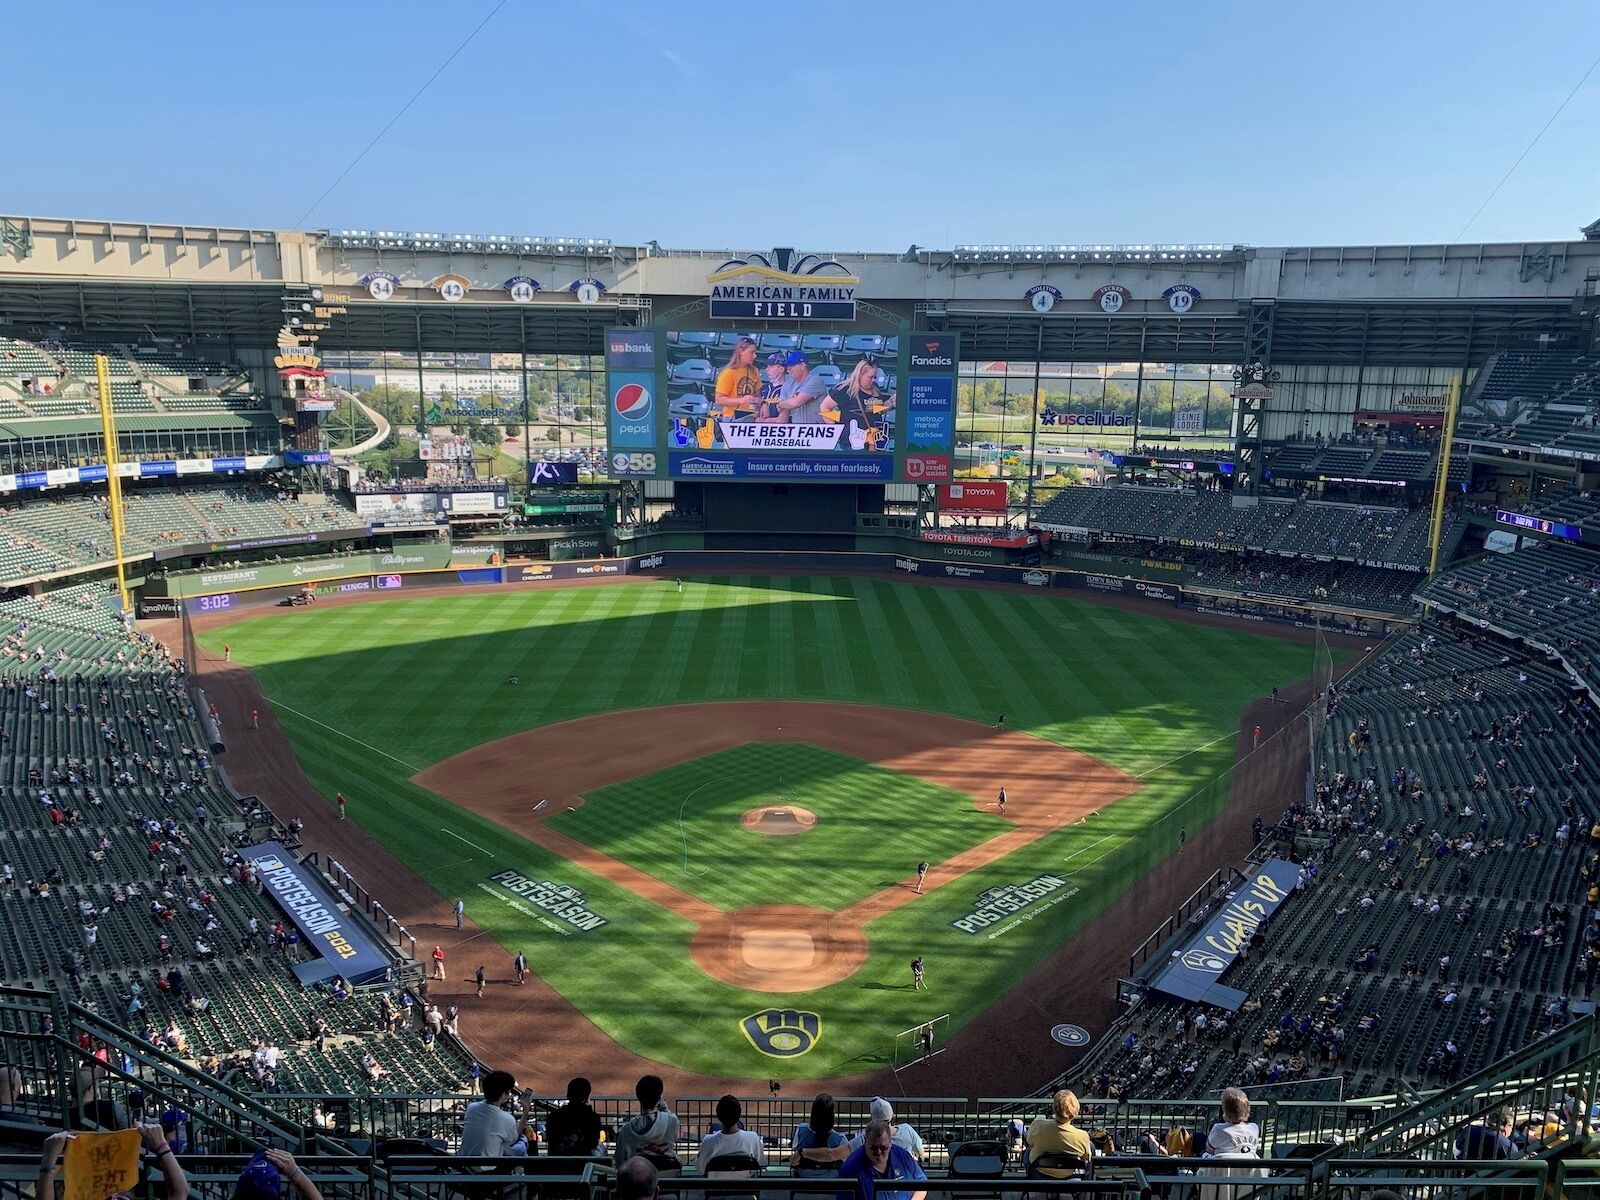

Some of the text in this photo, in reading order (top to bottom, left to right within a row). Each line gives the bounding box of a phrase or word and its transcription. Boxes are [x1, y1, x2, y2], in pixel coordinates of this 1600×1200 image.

[368, 272, 394, 281] FINGERS
[372, 282, 391, 295] 34
[443, 284, 462, 297] 42
[513, 286, 530, 299] 44
[712, 286, 855, 300] AMERICAN FAMILY
[1030, 284, 1057, 294] MOLITOR
[1172, 285, 1193, 293] YOUNT
[1037, 295, 1046, 308] 4
[1105, 293, 1119, 305] 50
[1173, 295, 1190, 308] 19
[754, 302, 812, 317] FIELD
[911, 354, 952, 366] Fanatics
[444, 407, 525, 418] Associated Bank
[1177, 413, 1201, 421] LEINIE
[620, 424, 649, 435] pepsi
[729, 425, 835, 438] THE BEST FANS
[1177, 421, 1201, 430] LODGE
[751, 438, 812, 447] IN BASEBALL
[629, 453, 657, 471] 58
[748, 461, 882, 475] Insure carefully, dream fearlessly.
[965, 488, 996, 496] TOYOTA
[554, 539, 599, 549] Pick'n Save
[924, 533, 993, 544] TOYOTA TERRITORY
[1180, 538, 1194, 547] 620
[1196, 541, 1219, 550] WTMJ
[943, 547, 992, 558] TOYOTA.COM
[382, 554, 406, 565] Bally
[640, 554, 664, 569] meijer
[895, 558, 919, 573] meijer
[1140, 559, 1182, 571] UWM.EDU
[576, 564, 618, 574] Fleet Farm
[1366, 559, 1421, 573] MLB NETWORK
[201, 571, 258, 583] RESTAURANT
[1085, 575, 1124, 586] TOWN BANK
[1146, 585, 1164, 593] Aurora
[1145, 590, 1176, 601] Health Care
[200, 594, 230, 610] 3:02
[1250, 875, 1288, 903] UP
[263, 867, 342, 935] POSTSEASON
[490, 870, 607, 931] POSTSEASON
[952, 874, 1067, 934] POSTSEASON
[323, 930, 358, 960] 2021
